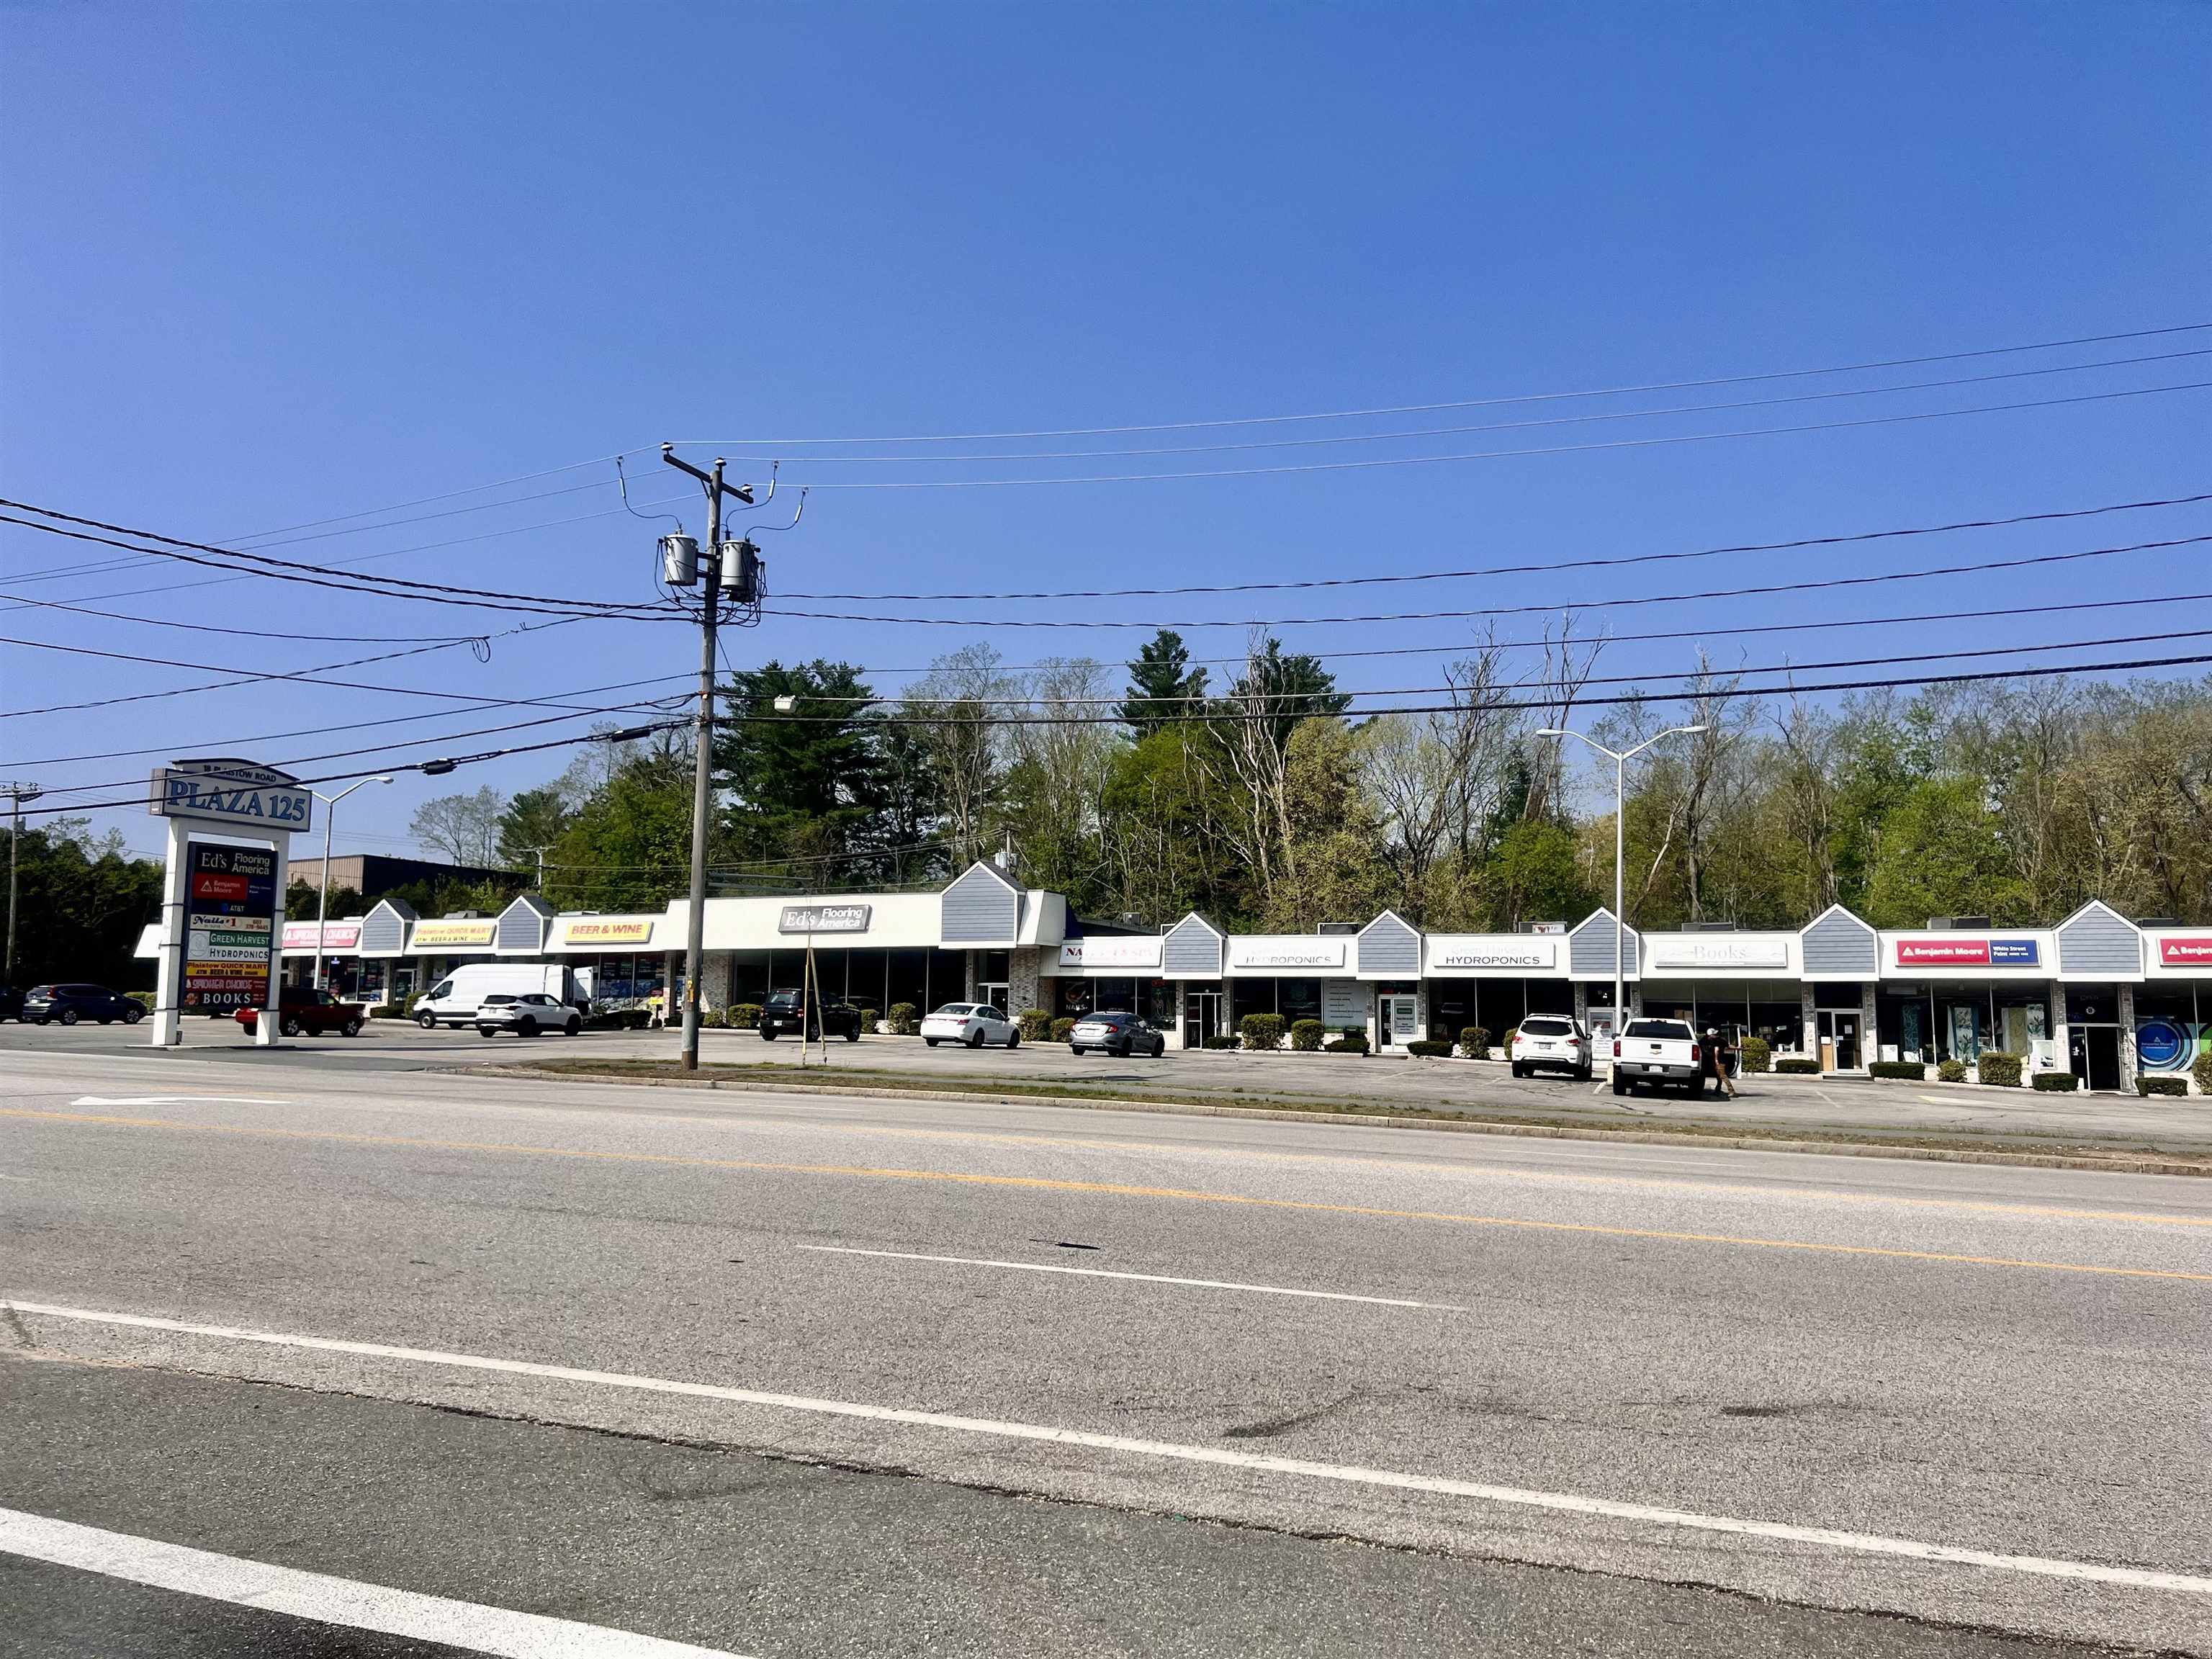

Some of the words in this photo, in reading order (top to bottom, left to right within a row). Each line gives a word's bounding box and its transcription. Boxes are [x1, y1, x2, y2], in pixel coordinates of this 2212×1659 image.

[214, 766, 253, 778] PLISTOW
[255, 773, 276, 783] ROAD
[167, 780, 264, 817] PLAZA
[269, 794, 306, 822] 125
[201, 852, 228, 868] Ed's
[234, 853, 271, 867] Flooring
[232, 863, 270, 875] America
[214, 880, 240, 889] Benjamin
[783, 910, 816, 927] Ed's
[822, 907, 863, 920] Flooring
[192, 915, 225, 925] Nails
[817, 917, 860, 928] America
[571, 925, 600, 934] BEER
[601, 925, 611, 934] &
[612, 925, 643, 934] WINE
[210, 933, 235, 943] GREEN
[237, 934, 270, 945] HARVEST
[210, 948, 269, 959] HYDROPONICS
[1693, 945, 1747, 958] Books
[1914, 947, 1954, 957] Benjamin
[1445, 956, 1540, 965] HYDROPONICS
[203, 993, 251, 1004] BOOKS
